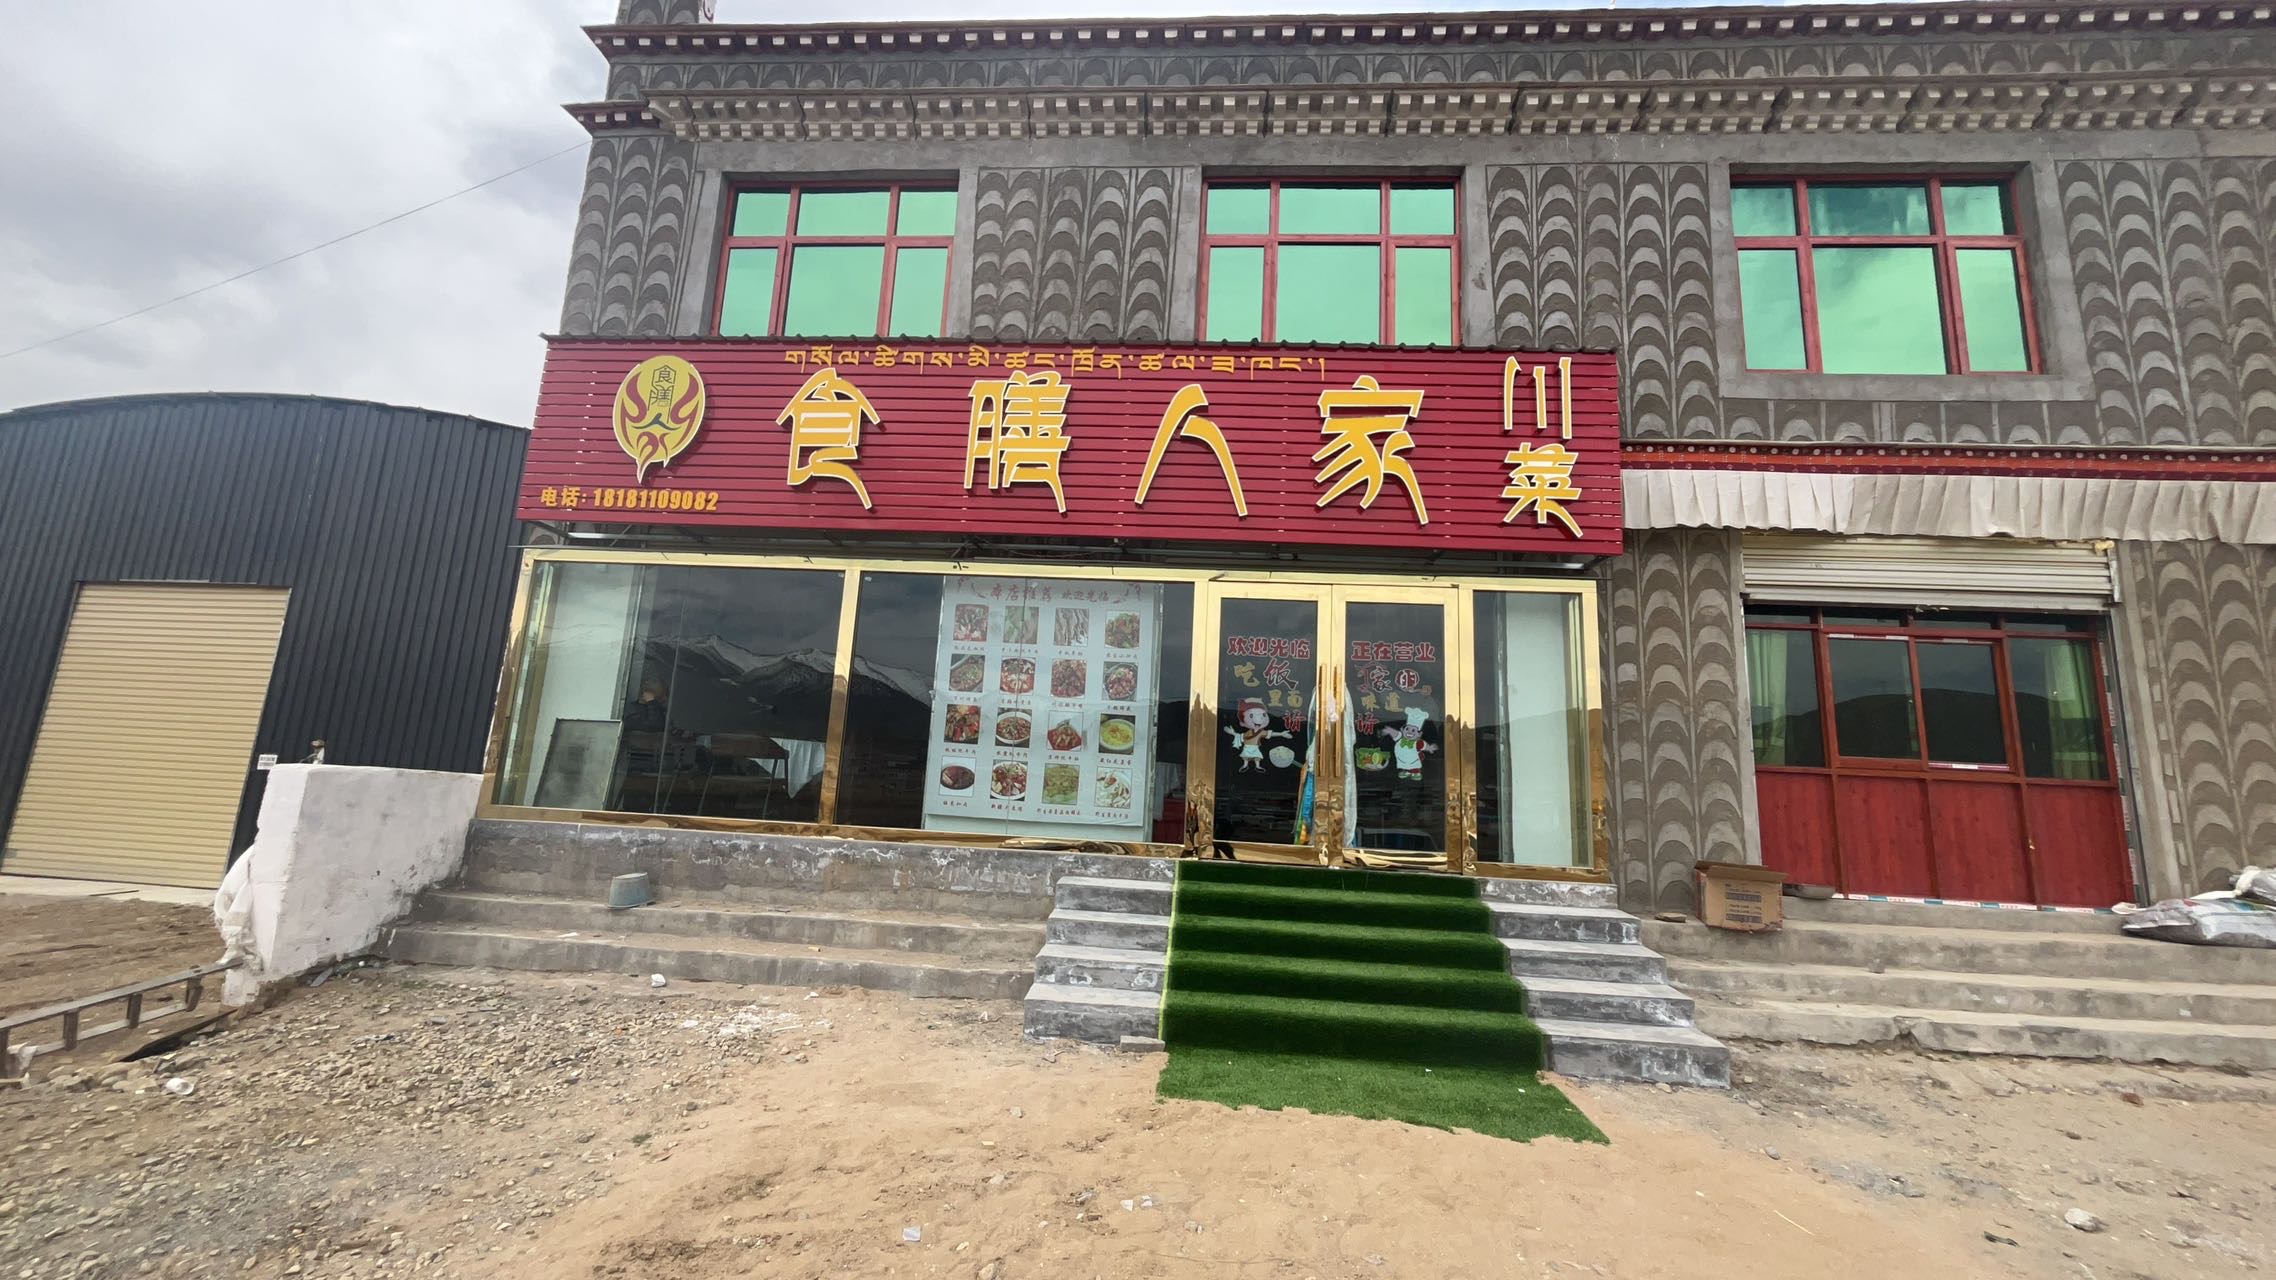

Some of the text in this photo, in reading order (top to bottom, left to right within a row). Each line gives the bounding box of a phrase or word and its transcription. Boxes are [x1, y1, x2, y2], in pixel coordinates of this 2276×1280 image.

[775, 366, 1429, 527] 食膳人家
[1501, 355, 1584, 539] 川菜
[593, 487, 720, 511] 18181109082
[1227, 636, 1311, 659] 欢迎光临
[1351, 641, 1436, 662] 正在营业
